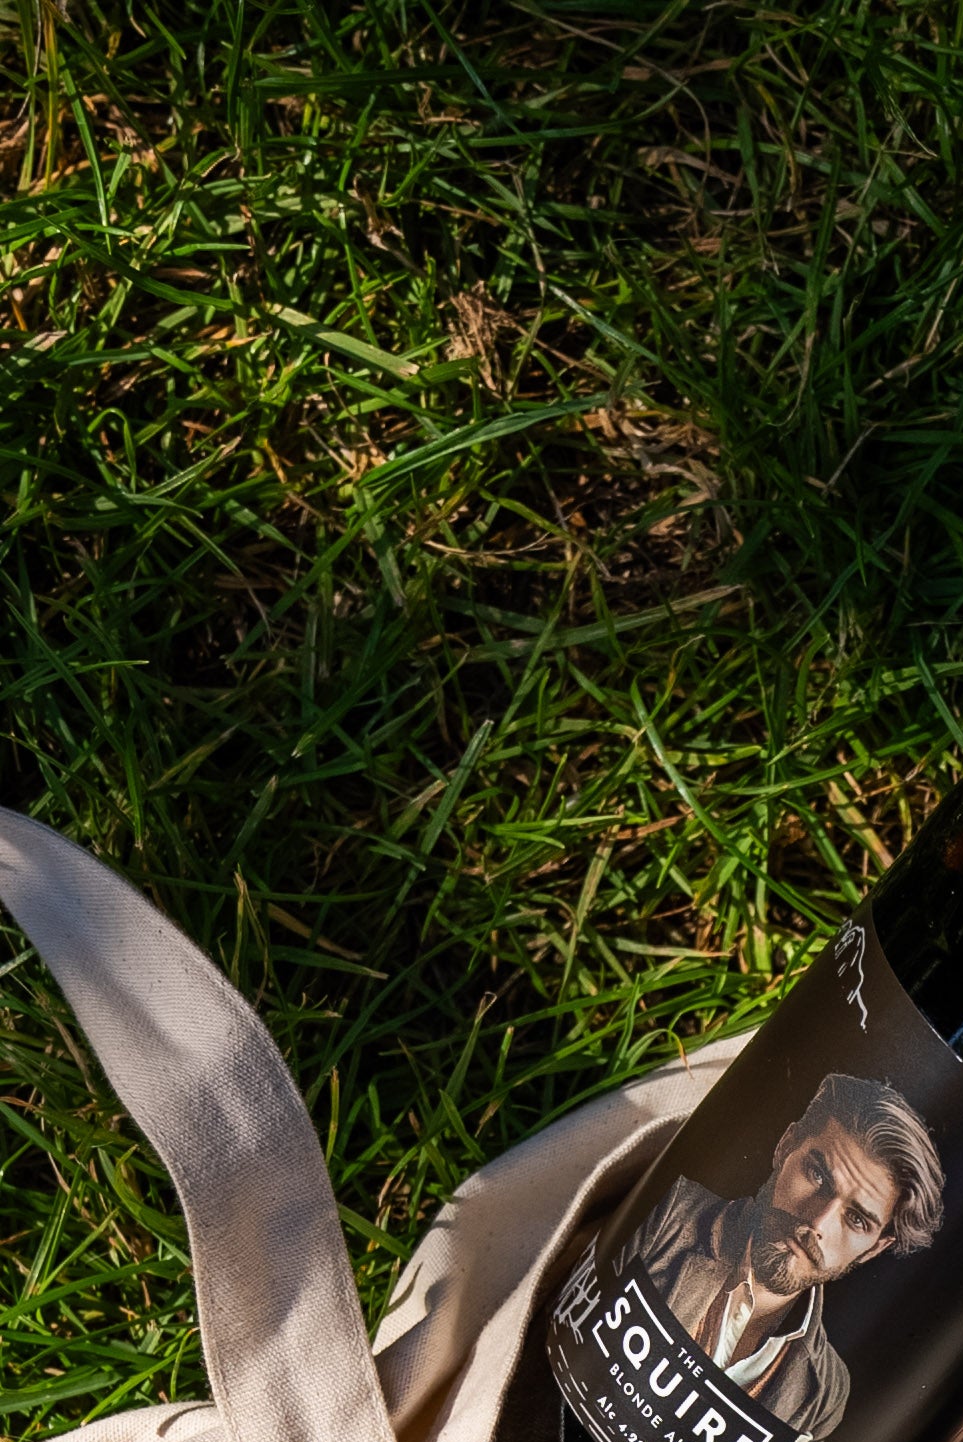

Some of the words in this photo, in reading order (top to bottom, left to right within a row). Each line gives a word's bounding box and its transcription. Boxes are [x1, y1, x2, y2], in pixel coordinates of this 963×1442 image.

[675, 1347, 704, 1378] THE
[597, 1396, 616, 1420] Alc
[609, 1363, 663, 1429] BLONDE
